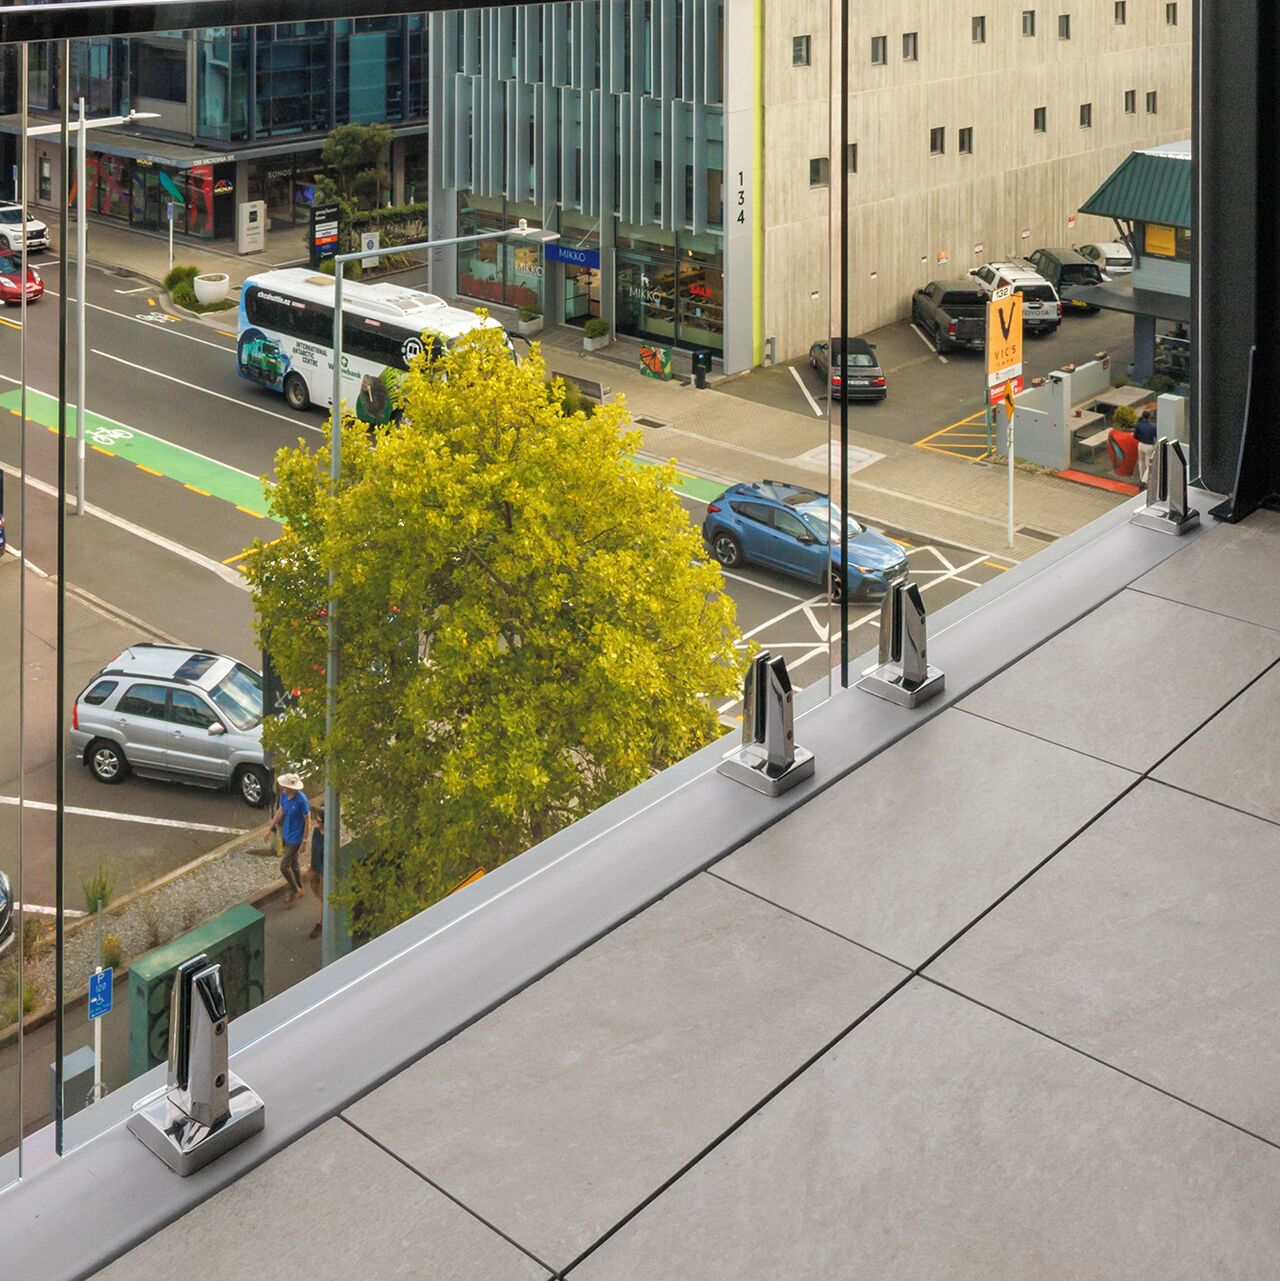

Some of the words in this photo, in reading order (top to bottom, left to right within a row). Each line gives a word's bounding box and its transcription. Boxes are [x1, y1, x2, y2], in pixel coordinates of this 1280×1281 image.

[737, 171, 745, 224] 134
[559, 249, 586, 262] MIKKO
[515, 261, 544, 277] MIKKO
[629, 287, 661, 302] MIKKO
[688, 283, 712, 297] SALE
[996, 288, 1009, 298] 132
[292, 347, 315, 359] ANTARCTIC
[296, 341, 328, 357] INTERNATIONAL
[302, 356, 318, 367] CENTRE
[97, 972, 105, 985] P
